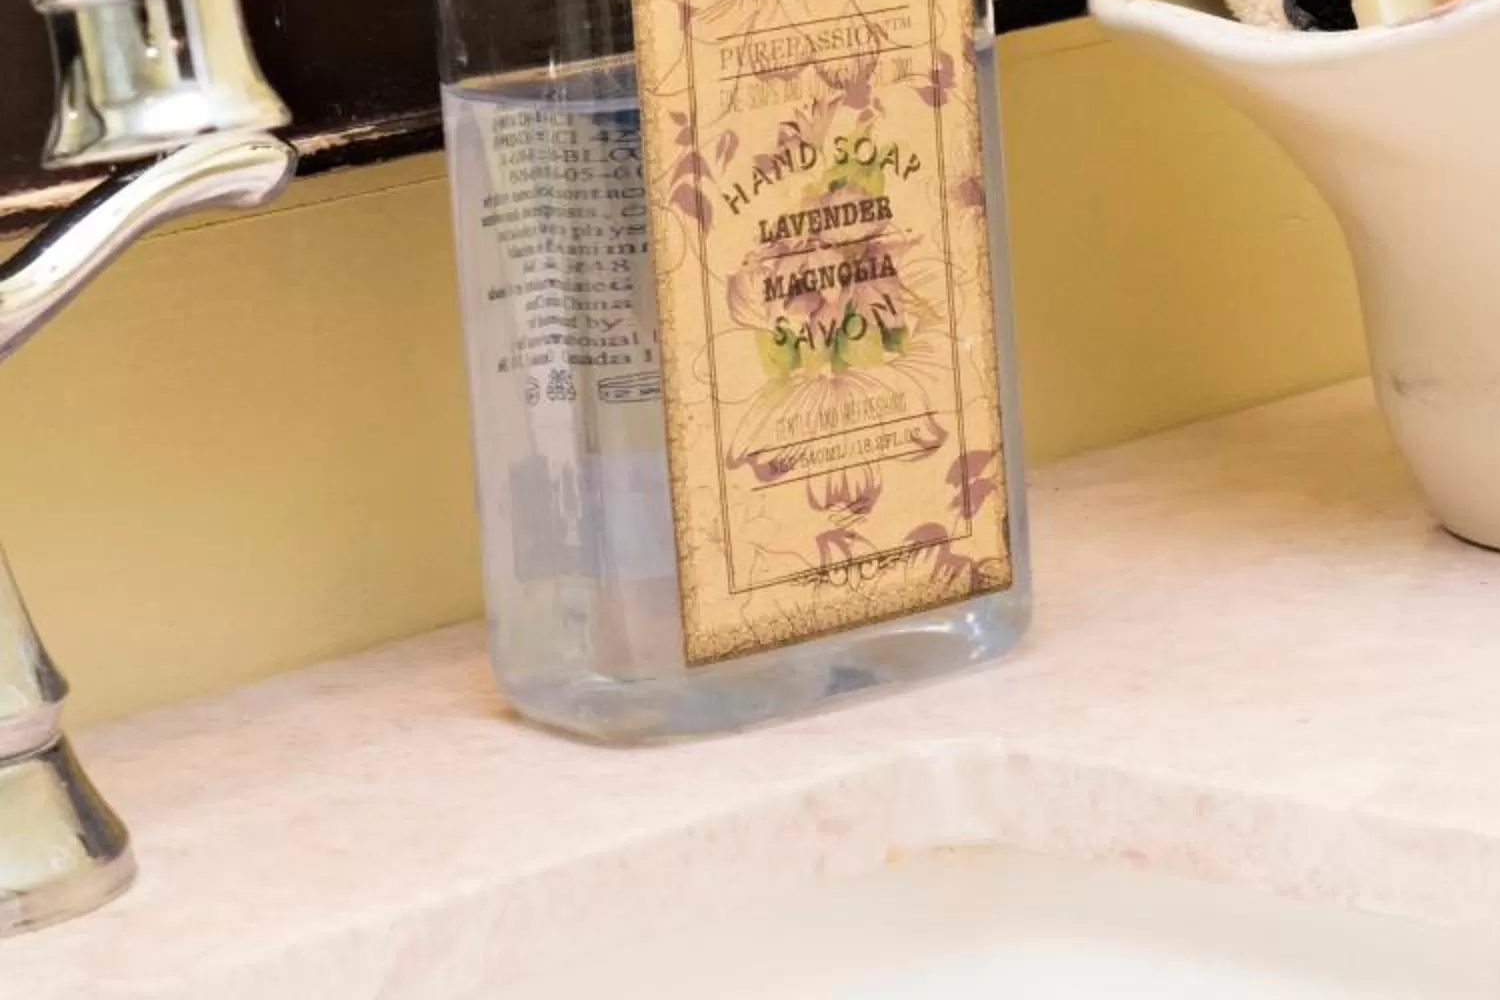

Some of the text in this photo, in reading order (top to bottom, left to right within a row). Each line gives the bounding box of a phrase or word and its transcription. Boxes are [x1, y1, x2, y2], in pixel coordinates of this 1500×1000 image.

[722, 136, 921, 215] HAND SOAP
[758, 195, 893, 244] LAVENDER
[763, 253, 897, 302] MAGNOLIA
[773, 293, 897, 350] SAVON
